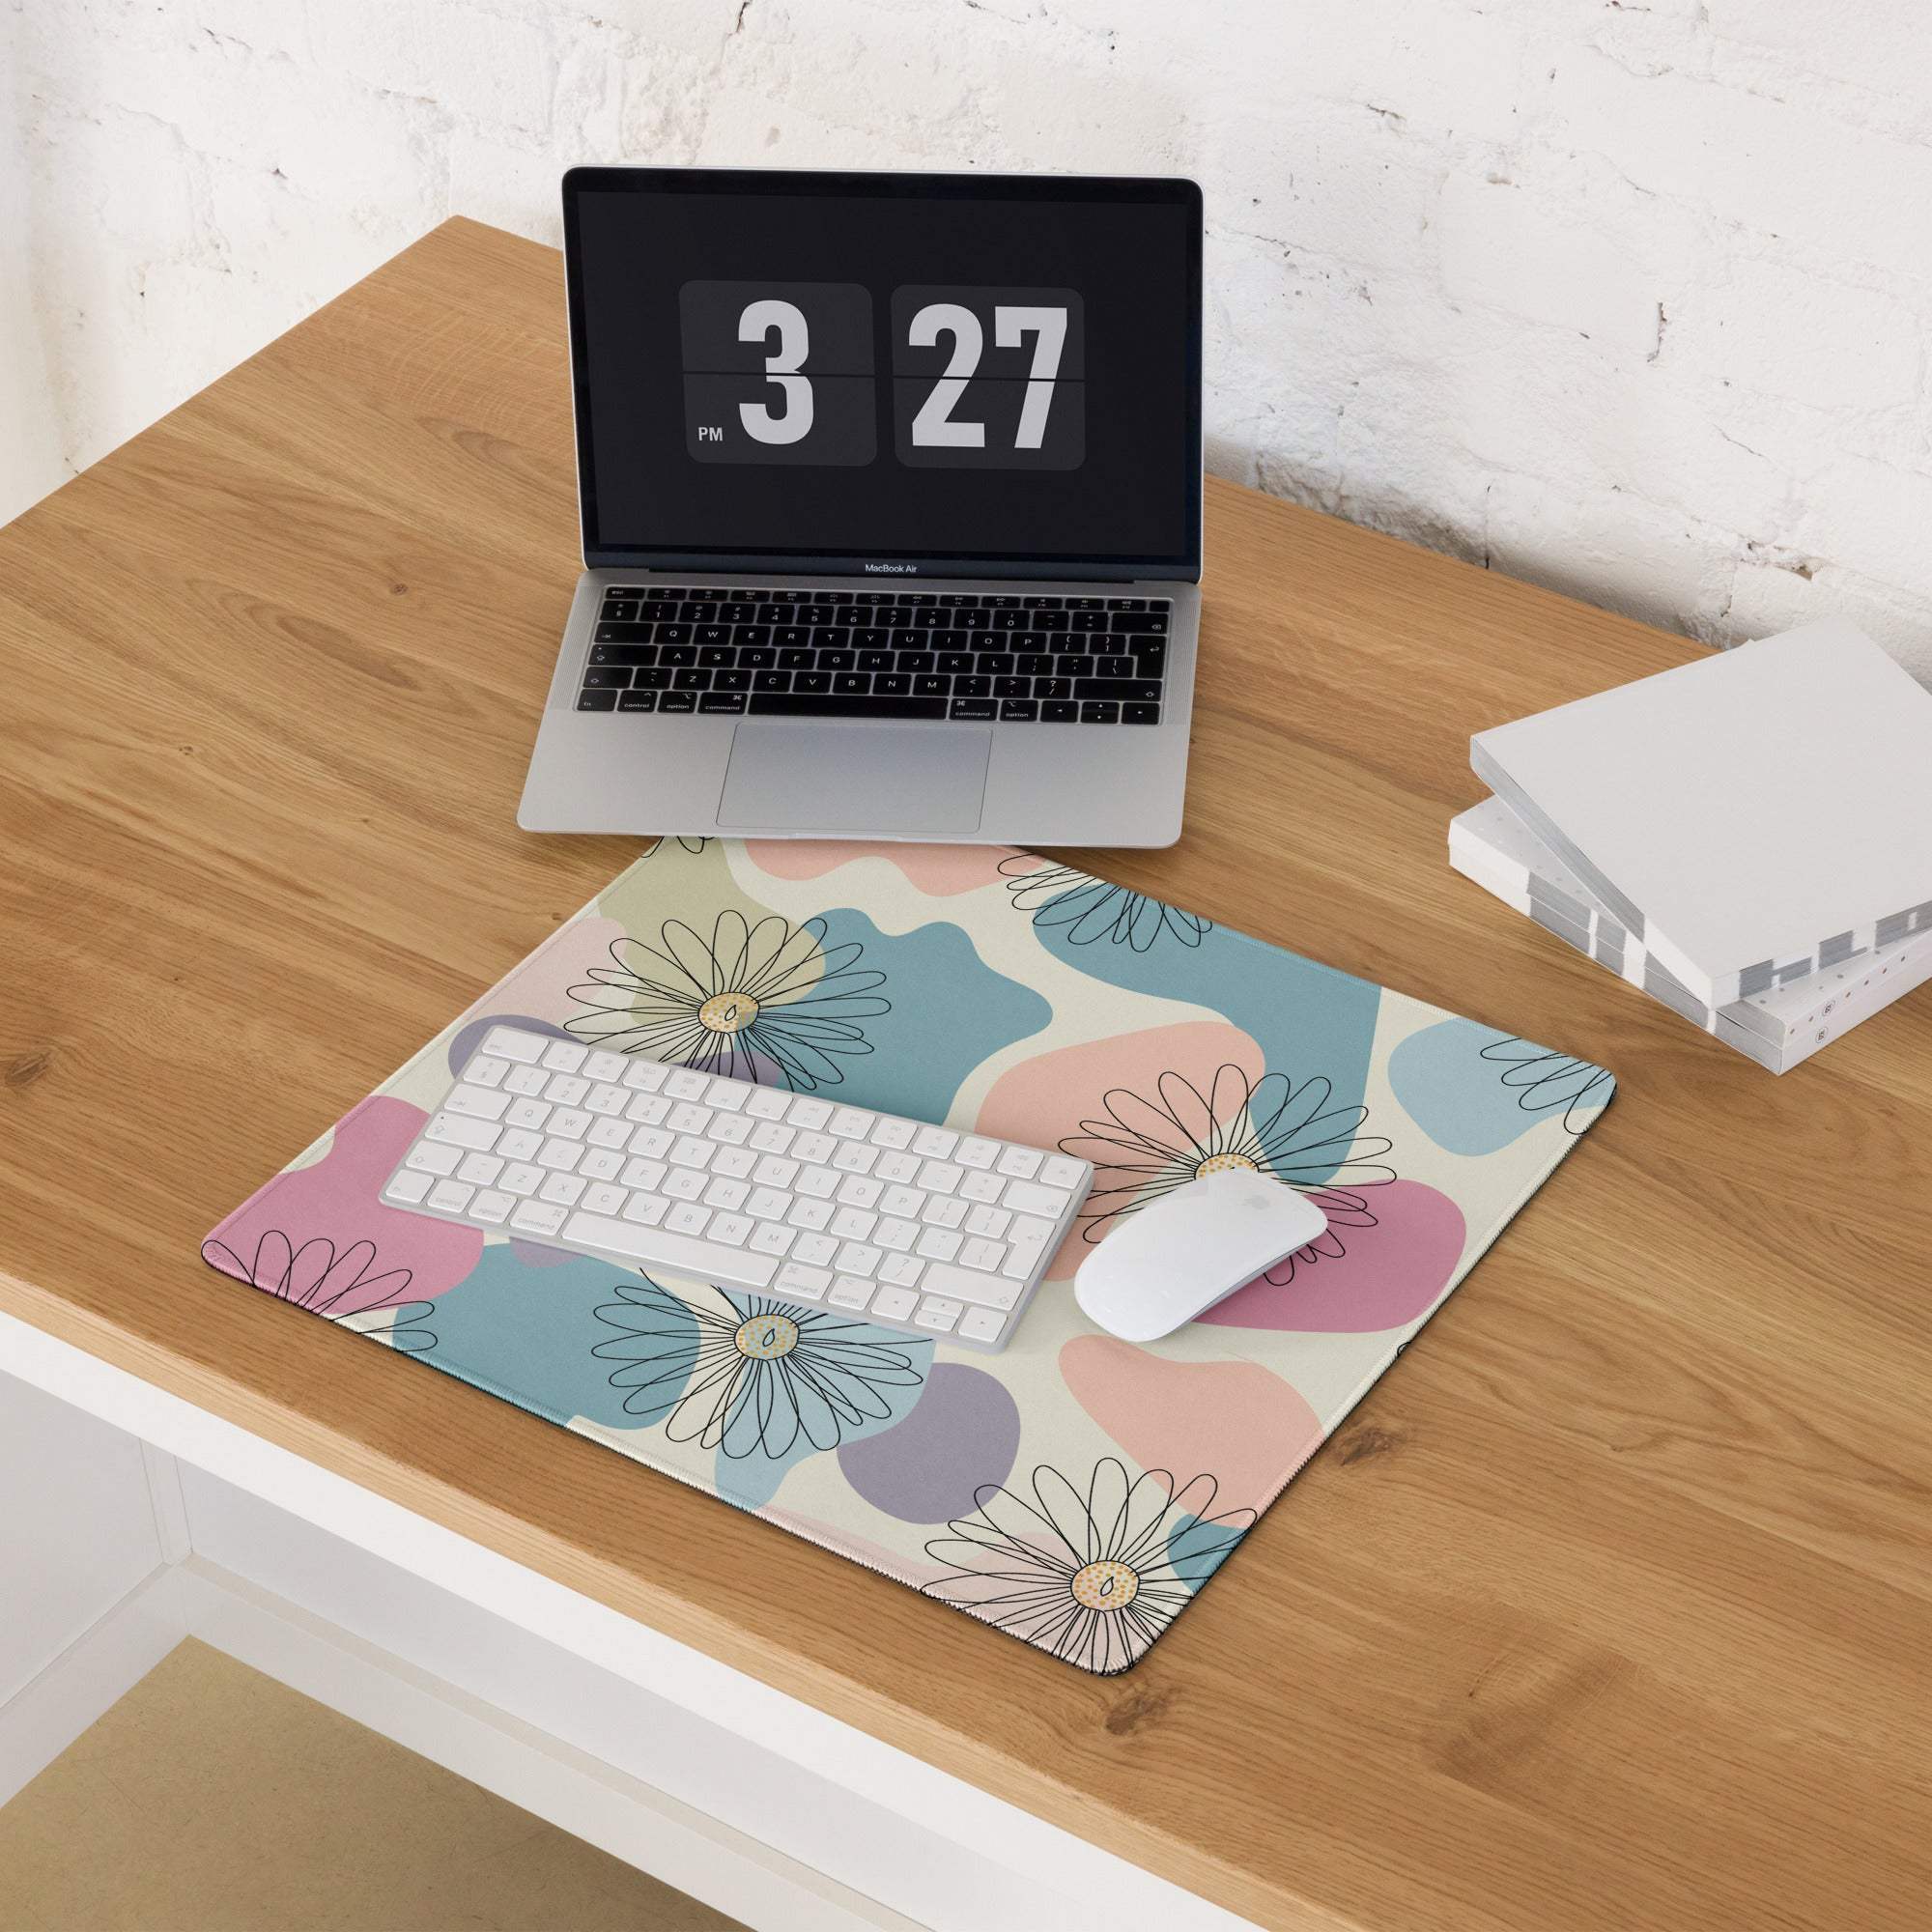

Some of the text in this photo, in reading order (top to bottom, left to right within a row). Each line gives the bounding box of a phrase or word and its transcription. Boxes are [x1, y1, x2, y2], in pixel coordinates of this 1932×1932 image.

[738, 299, 814, 445] 3
[908, 303, 1067, 449] 27
[698, 427, 723, 441] PM
[865, 564, 918, 573] MacBook Air
